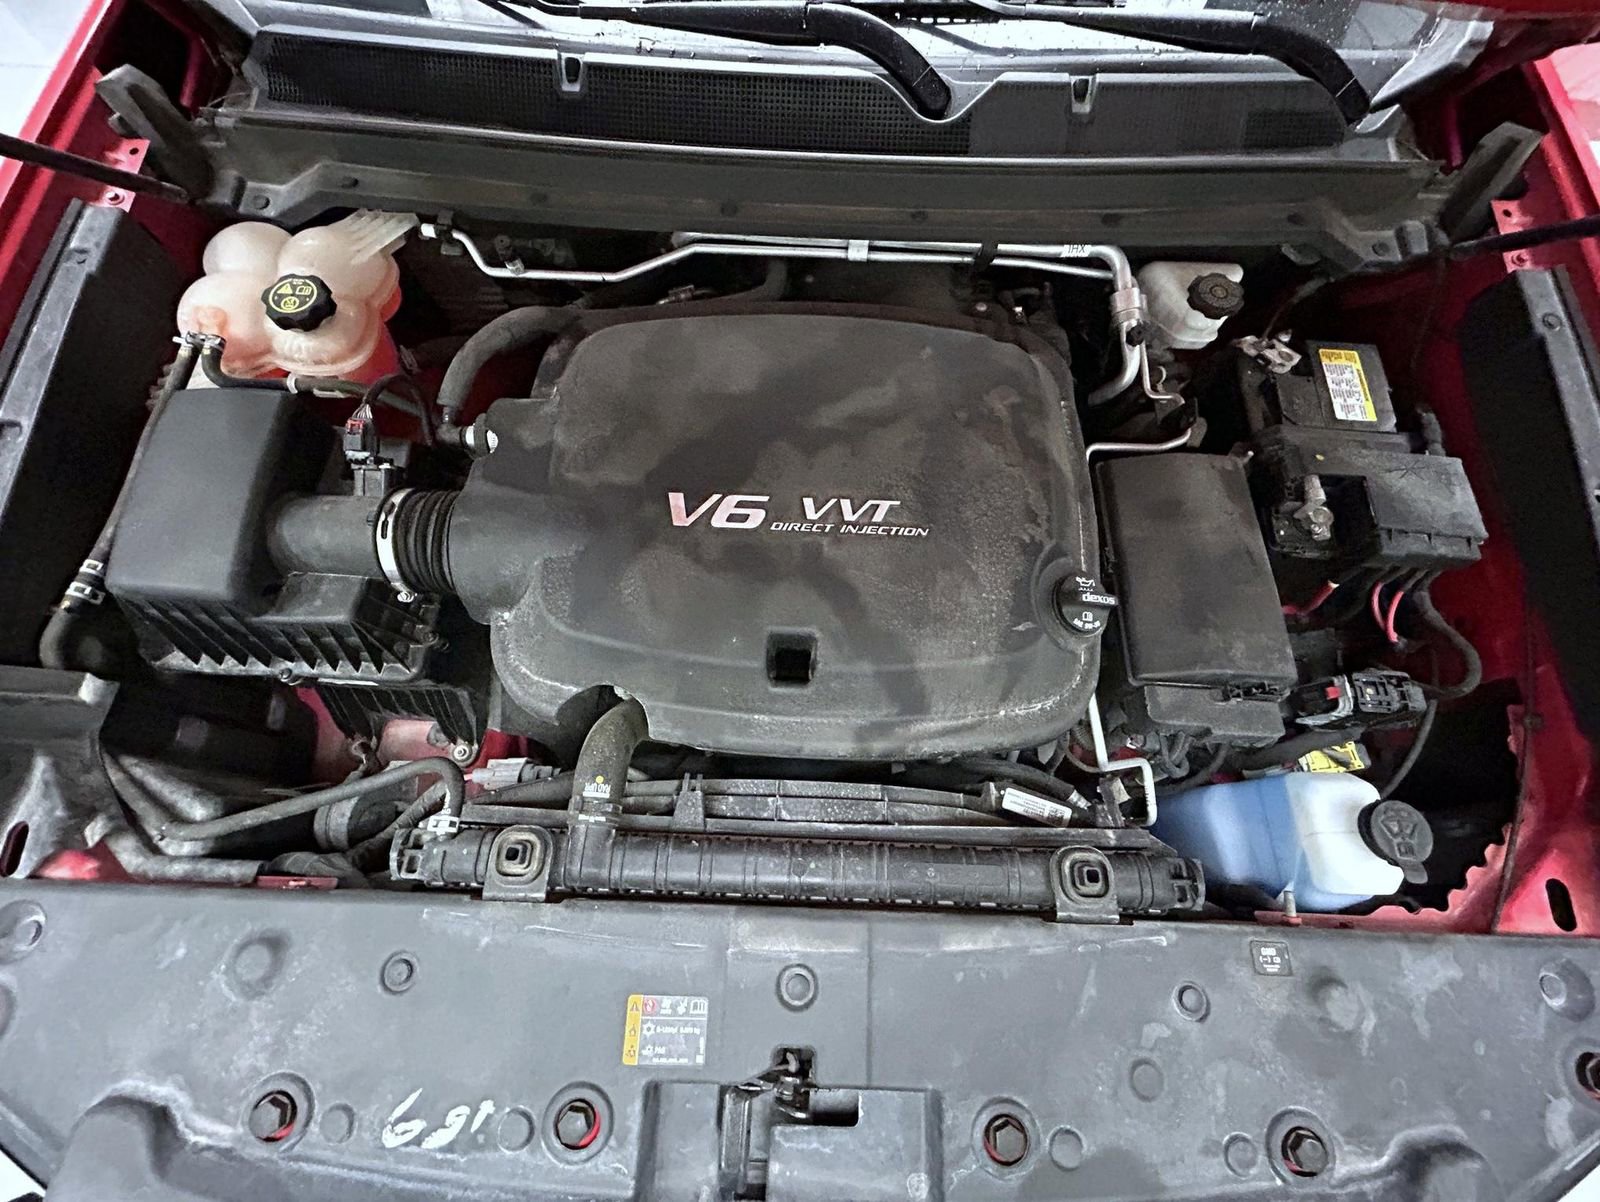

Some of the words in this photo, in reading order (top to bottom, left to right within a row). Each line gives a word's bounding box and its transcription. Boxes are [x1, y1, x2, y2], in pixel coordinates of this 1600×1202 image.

[668, 492, 770, 529] V6
[802, 497, 901, 522] VVT
[770, 521, 835, 534] DIRECT
[839, 524, 930, 537] INJECTION
[1082, 592, 1116, 605] dexos
